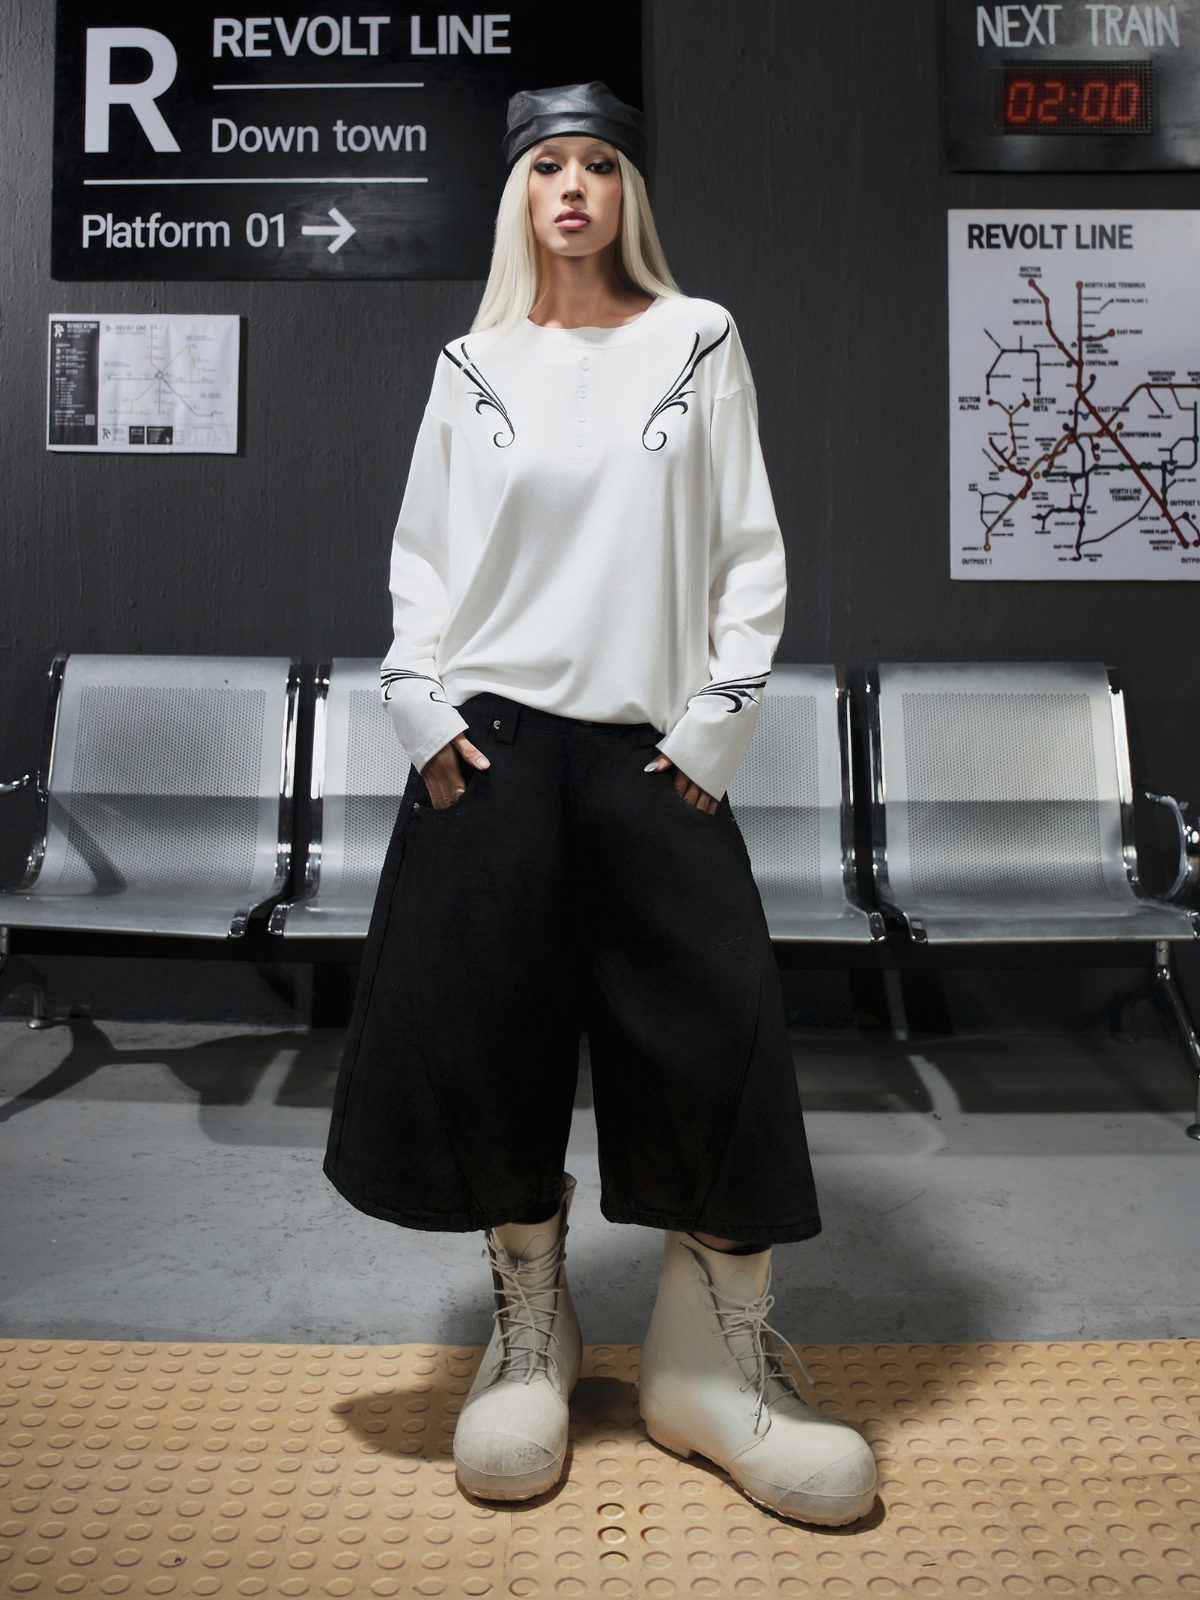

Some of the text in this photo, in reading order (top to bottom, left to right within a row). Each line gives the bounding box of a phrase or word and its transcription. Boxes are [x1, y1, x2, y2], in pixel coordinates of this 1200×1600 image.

[213, 14, 511, 58] REVOLT LINE
[977, 5, 1179, 47] NEXT TRAIN
[84, 27, 182, 153] R
[1007, 81, 1140, 122] 02:00
[211, 119, 427, 153] Down town
[82, 212, 286, 249] Platform 01
[968, 224, 1133, 250] REVOLT LINE
